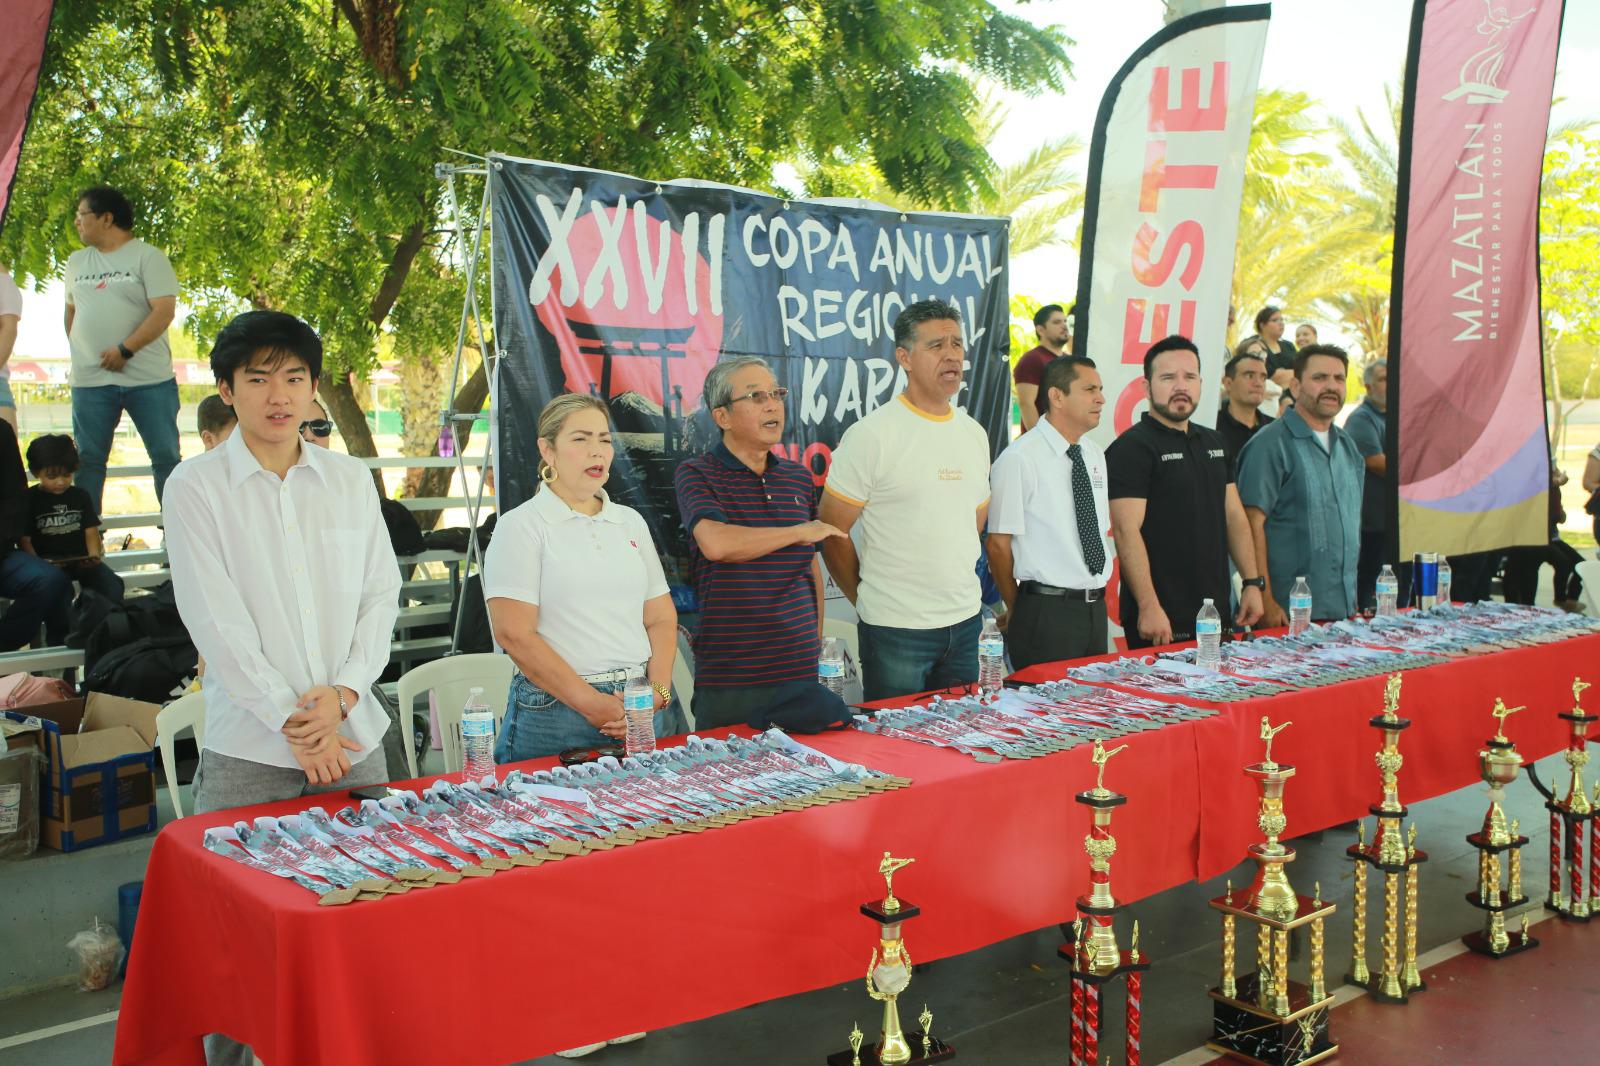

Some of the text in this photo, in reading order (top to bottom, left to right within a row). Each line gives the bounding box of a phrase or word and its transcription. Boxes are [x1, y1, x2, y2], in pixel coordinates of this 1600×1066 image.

[529, 187, 725, 316] XXVII
[742, 213, 1004, 287] COPA ANUAL
[1452, 123, 1486, 342] MAZATLÁN
[1489, 122, 1503, 340] BIENESTAR PARA TODOS
[777, 285, 986, 352] REGIOAL
